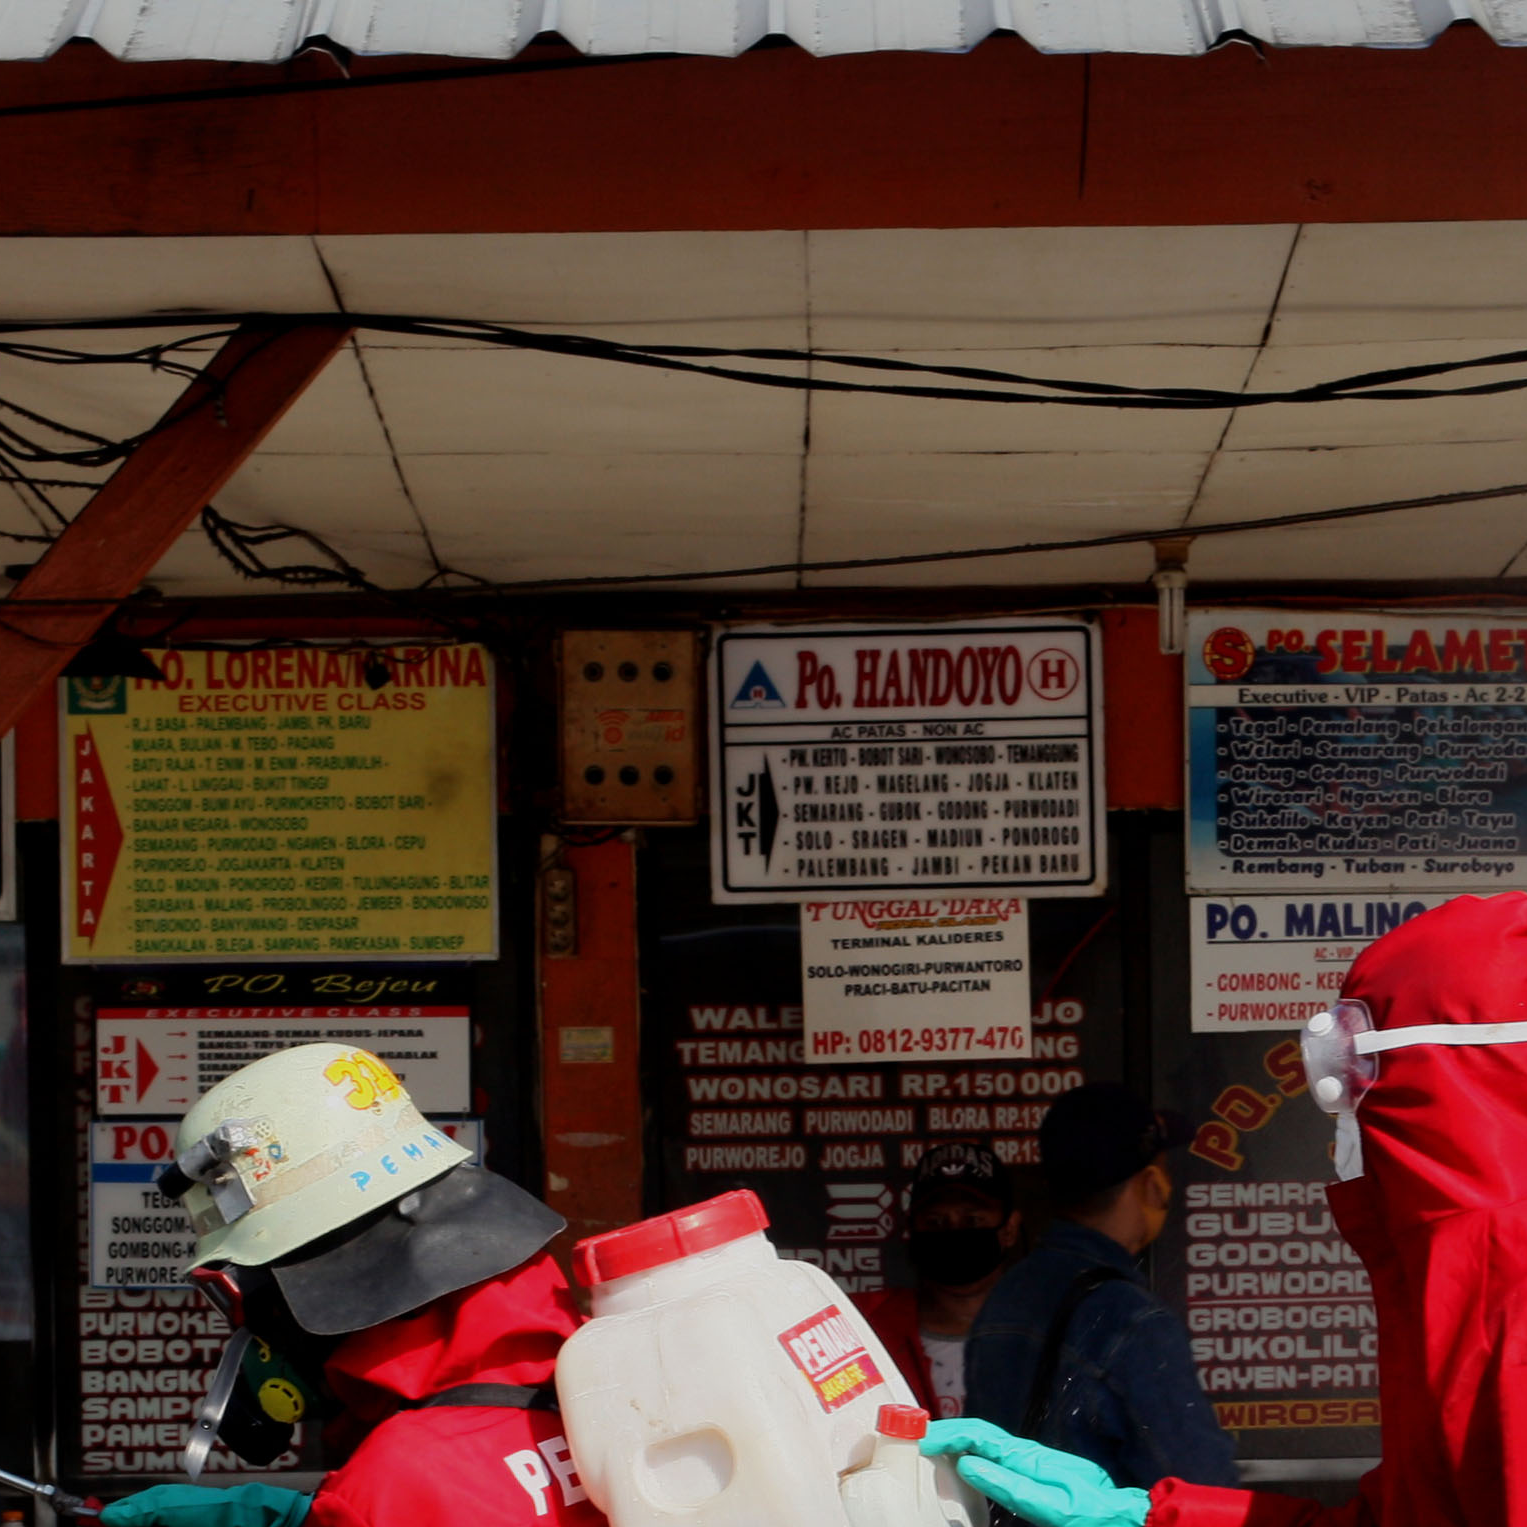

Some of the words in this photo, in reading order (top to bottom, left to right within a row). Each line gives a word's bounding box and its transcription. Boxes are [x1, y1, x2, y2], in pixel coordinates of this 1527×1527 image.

[1266, 630, 1311, 653] PO.
[795, 651, 841, 709] Po.
[853, 646, 1022, 708] HANDOYO
[179, 693, 327, 712] EXECUTIVE
[337, 692, 426, 711] CLASS
[1238, 688, 1328, 704] Executive
[1345, 688, 1380, 703] VIP
[1397, 687, 1449, 703] Patas
[1465, 687, 1489, 703] Ac
[1496, 686, 1526, 702] 2-2
[831, 726, 853, 739] AC
[857, 725, 906, 738] PATAS
[923, 724, 958, 737] NON
[962, 723, 984, 736] AC
[1232, 718, 1287, 739] Tegal
[1300, 718, 1399, 739] Pemalang
[825, 776, 858, 794] REJO
[877, 774, 949, 793] MAGELANG
[967, 773, 1009, 791] JOGJA
[1028, 771, 1078, 790] KLATEN
[1232, 812, 1308, 830] Sukolilo
[1326, 811, 1389, 832] Kayen
[1405, 810, 1447, 829] Pati
[1464, 812, 1515, 829] Tayu
[79, 741, 95, 926] JAKARTA
[796, 830, 832, 850] SOLO
[852, 830, 908, 848] SRAGEN
[927, 828, 983, 847] MADIUN
[1002, 827, 1079, 845] PONOROGO
[797, 858, 889, 877] PALEMBANG
[912, 857, 959, 876] JAMBI
[982, 855, 1031, 875] PEKAN
[1040, 854, 1079, 873] BARU
[1232, 859, 1324, 877] Rembang
[1344, 859, 1405, 874] Tuban
[1424, 859, 1515, 876] Suroboyo
[1206, 903, 1269, 940] PO.
[831, 936, 911, 950] TERMINAL
[917, 931, 1003, 946] KALIDERES
[808, 959, 1023, 978] SOLO-WONOGIRI-PURWANTORO
[845, 980, 990, 996] PRACI-BATU-PACITAN
[1217, 972, 1301, 993] GOMBONG
[145, 1008, 315, 1018] EXECUTIVE
[323, 1007, 424, 1018] CLASS
[813, 1031, 851, 1054] HP:
[687, 1073, 885, 1102] WONOSARI
[689, 1111, 792, 1136] SEMARANG
[804, 1108, 915, 1134] PURWODADI
[926, 1106, 991, 1131] BLORA
[685, 1144, 806, 1171] PURWOREJO
[820, 1142, 886, 1168] JOGJA
